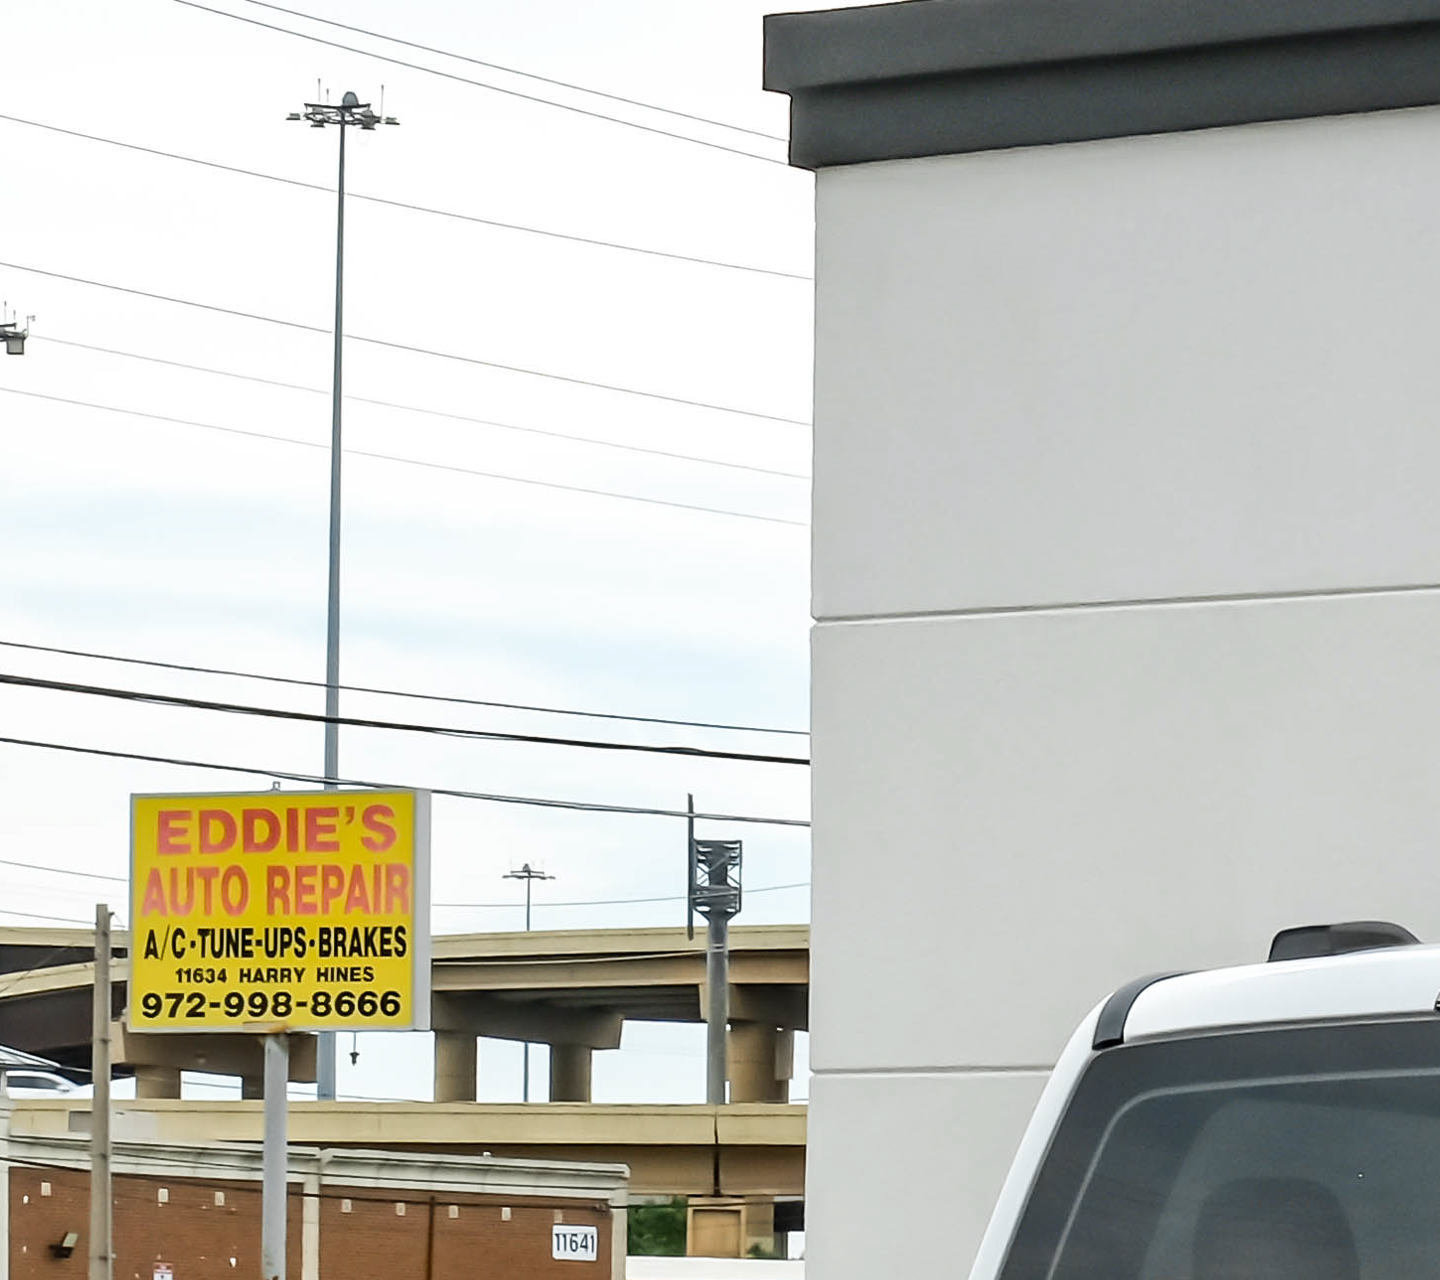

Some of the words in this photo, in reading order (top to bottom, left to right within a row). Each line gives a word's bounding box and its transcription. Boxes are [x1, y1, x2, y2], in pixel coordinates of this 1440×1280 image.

[157, 804, 398, 855] EDDIE'S
[141, 864, 250, 917] AUTO
[266, 863, 410, 916] REPAIR
[175, 967, 227, 983] 11634
[239, 967, 305, 983] HARRY
[316, 966, 375, 982] HINES
[141, 990, 401, 1018] 972-998-8666
[554, 1233, 595, 1253] 11641
